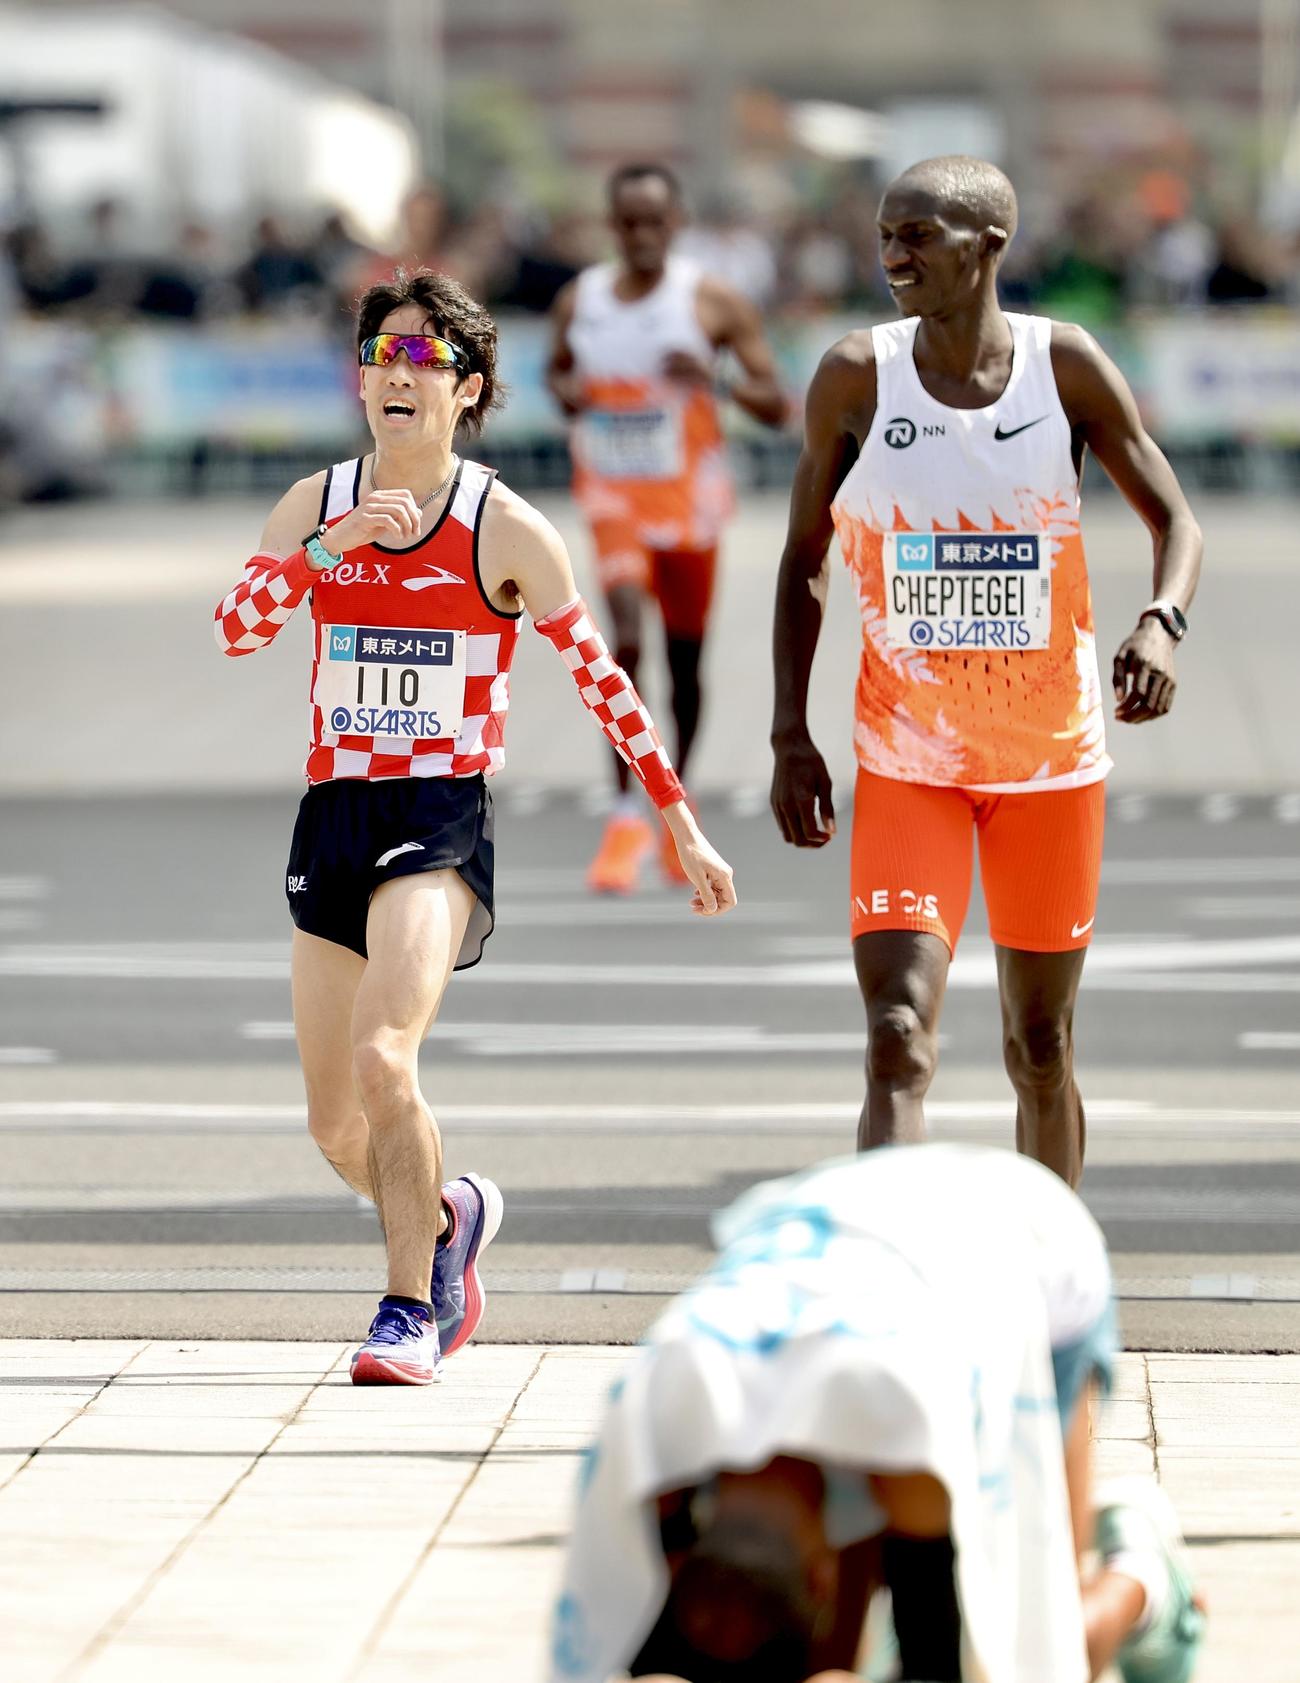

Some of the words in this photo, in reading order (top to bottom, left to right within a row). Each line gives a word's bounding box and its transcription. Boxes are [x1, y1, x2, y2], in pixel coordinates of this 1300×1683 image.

[923, 425, 945, 436] NN
[941, 542, 1033, 563] 東京メトロ
[893, 575, 1024, 616] CHEPTEGEI
[362, 637, 446, 657] 東京メトロ
[357, 666, 419, 707] 110
